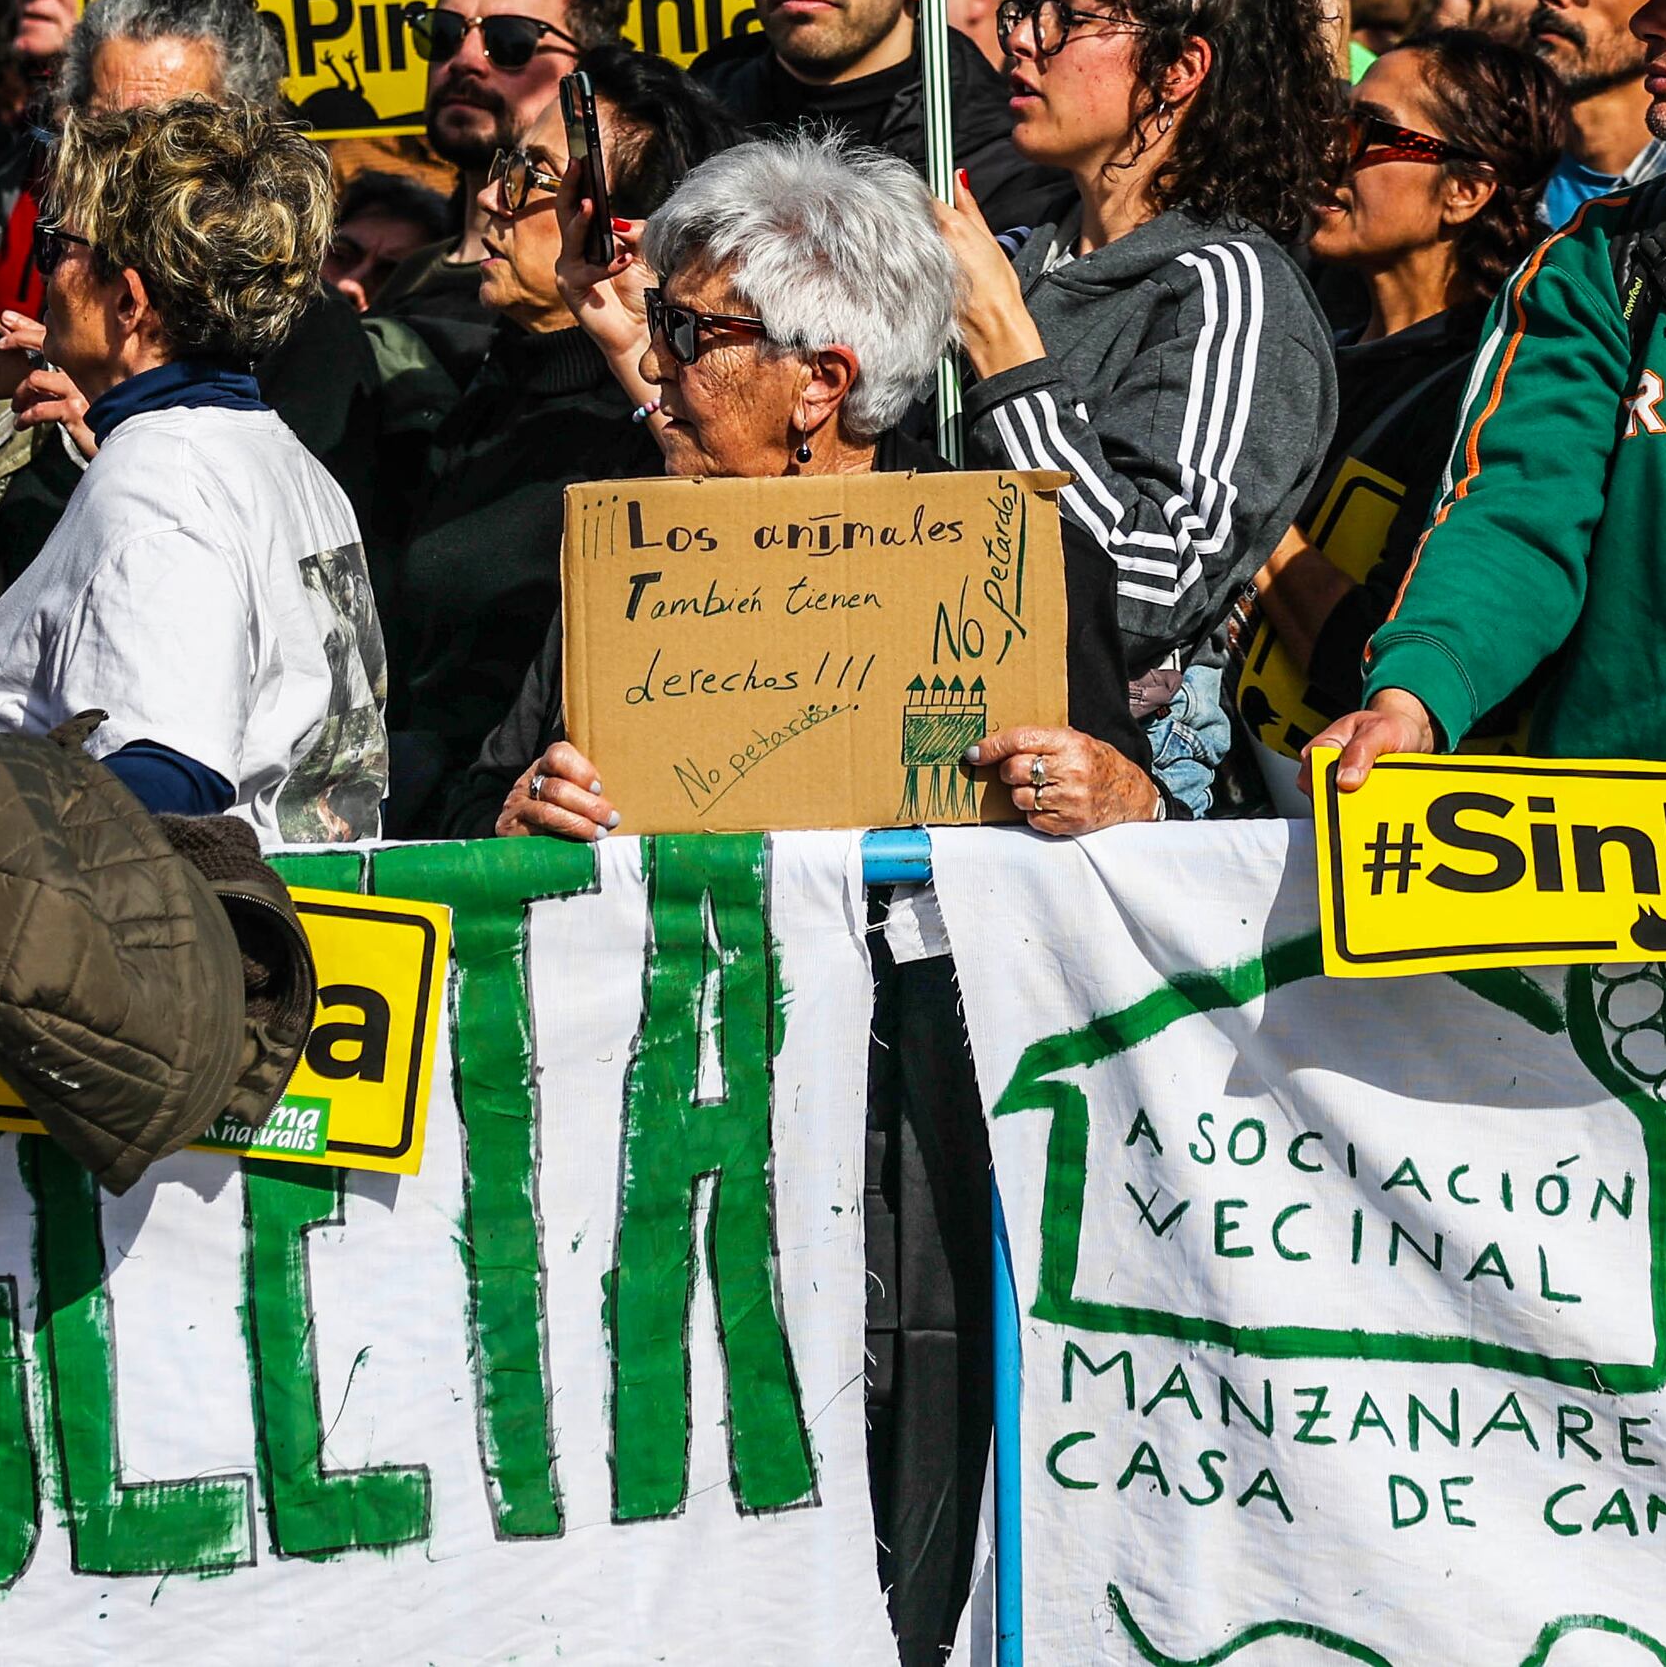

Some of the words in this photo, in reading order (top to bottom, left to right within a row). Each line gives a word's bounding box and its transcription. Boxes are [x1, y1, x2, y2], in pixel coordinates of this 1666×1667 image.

[1623, 276, 1643, 321] newfeel
[785, 576, 883, 615] tienen
[673, 756, 721, 808] No
[1125, 1182, 1584, 1304] VECINAL
[1046, 1431, 1295, 1524] CASA
[1387, 1474, 1478, 1530] DE
